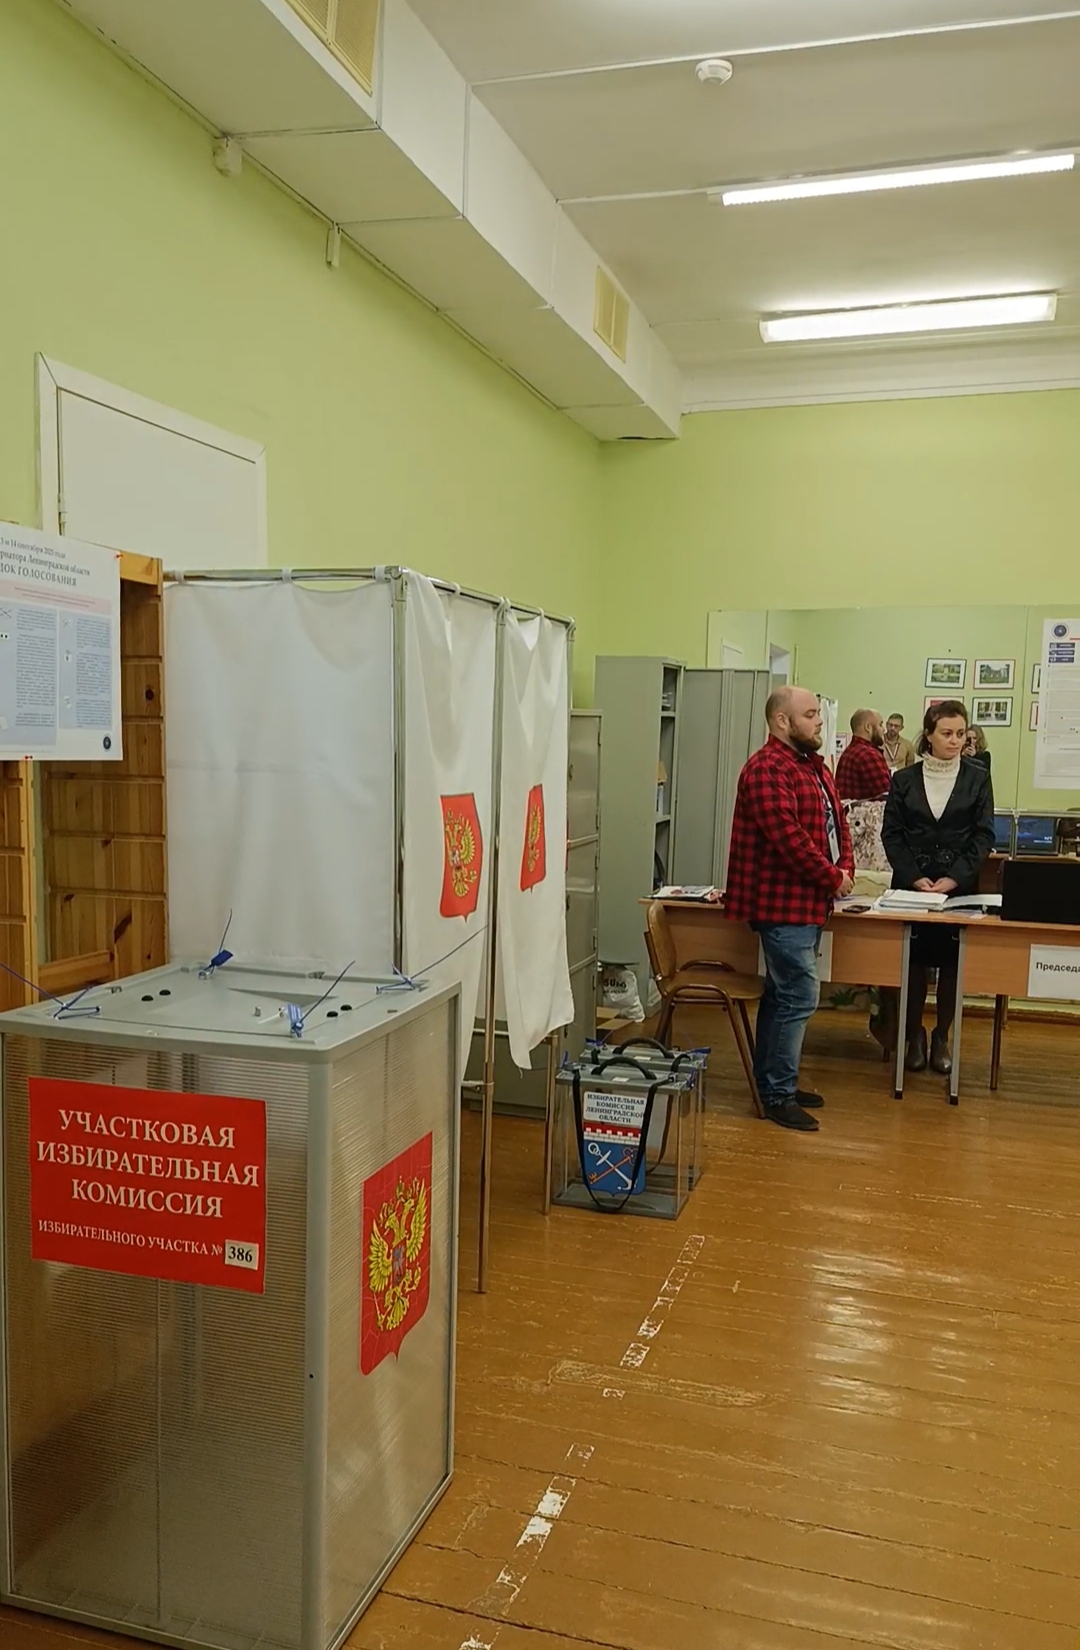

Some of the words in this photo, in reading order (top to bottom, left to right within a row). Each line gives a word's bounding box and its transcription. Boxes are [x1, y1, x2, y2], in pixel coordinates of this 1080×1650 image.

[18, 566, 77, 587] ГОЛОСОВАНИЯ
[587, 1094, 645, 1105] ИЗБИРАТЕЛЬНАЯ
[596, 1101, 635, 1111] КОМИССИЯ
[58, 1109, 236, 1149] УЧАСТКОВАЯ
[599, 1115, 631, 1123] ОБЛАСТИ
[37, 1141, 259, 1187] ИЗБИРАТЕЛЬНАЯ
[71, 1179, 223, 1218] КОМИССИЯ
[38, 1219, 145, 1246] ИЗБИРАТЕЛЬНОГО
[148, 1236, 208, 1255] УЧАСТКА
[211, 1244, 223, 1256] №
[228, 1246, 253, 1263] 386
